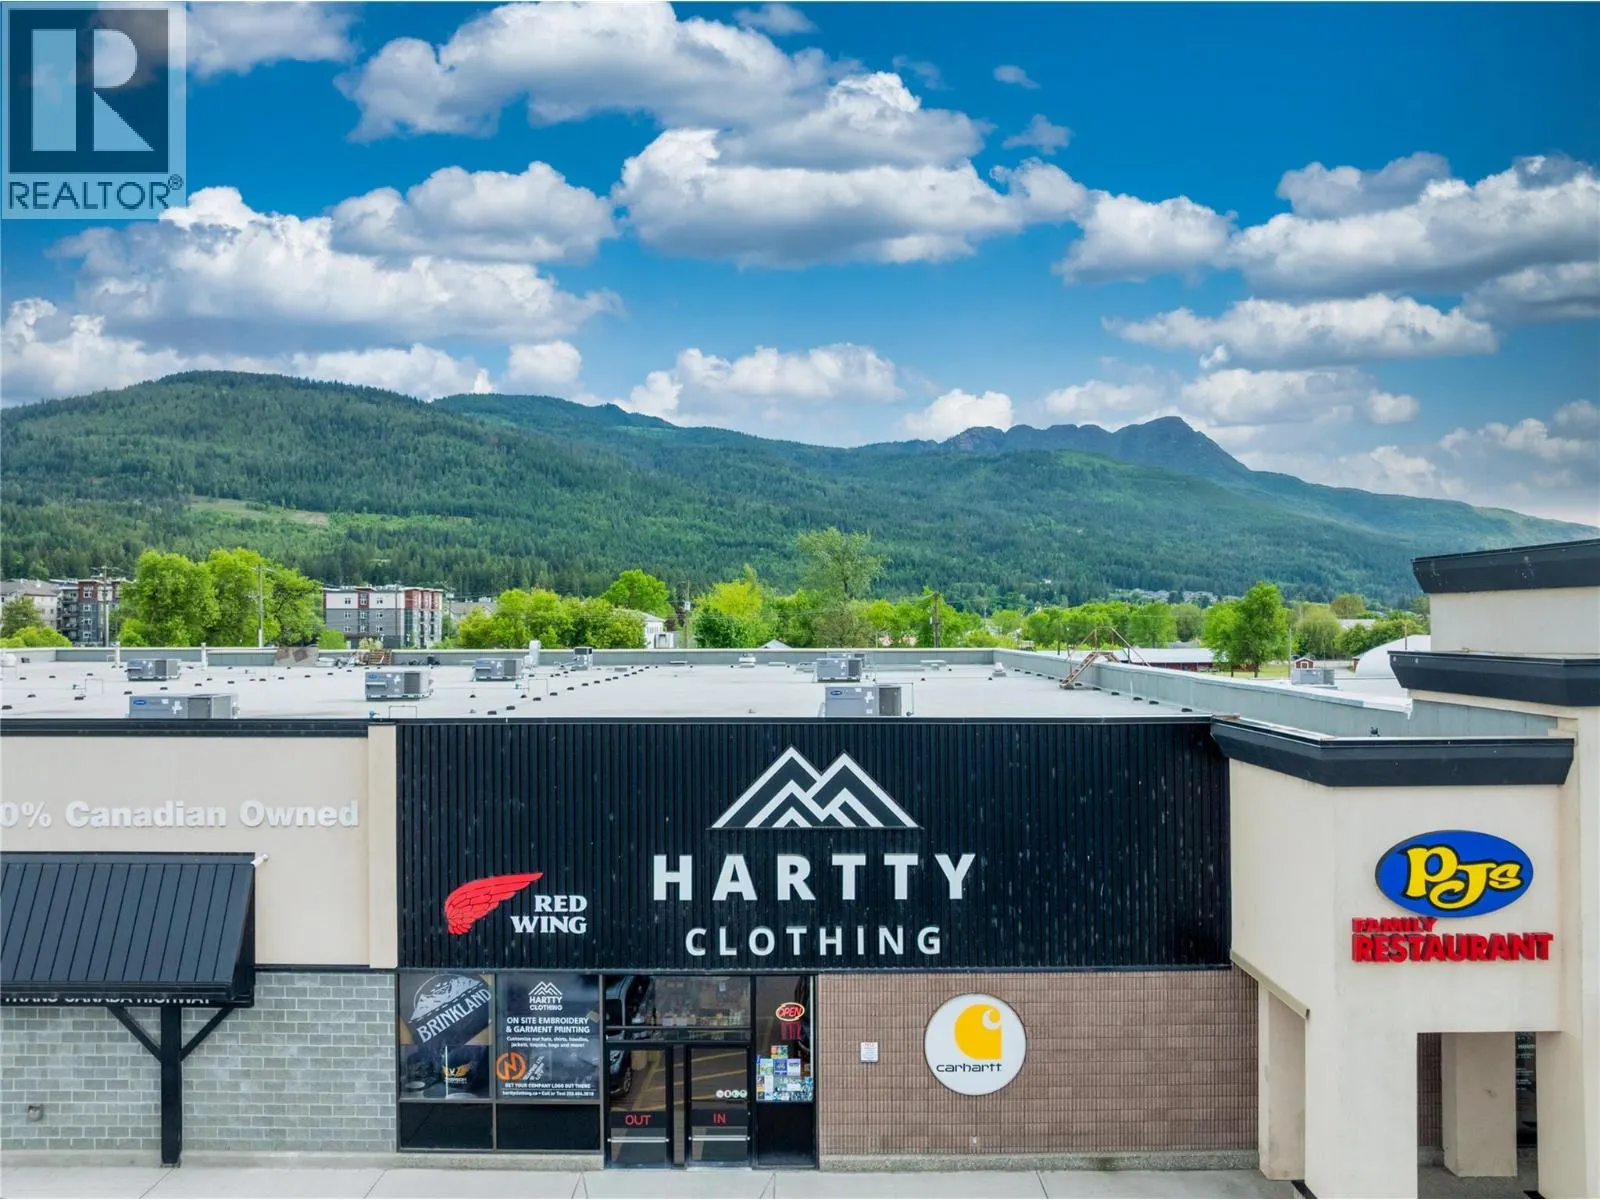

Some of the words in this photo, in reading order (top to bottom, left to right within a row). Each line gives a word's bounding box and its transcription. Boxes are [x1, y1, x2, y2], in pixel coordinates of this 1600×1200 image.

[65, 799, 227, 828] Canadian
[239, 799, 359, 828] Owned
[653, 854, 976, 901] HARTTY
[534, 895, 588, 913] RED
[510, 915, 588, 935] WING
[1352, 917, 1438, 932] FAMILY
[685, 926, 942, 957] CLOTHING
[1352, 932, 1554, 962] RESTAURANT
[529, 996, 563, 1004] HARTTY
[416, 988, 492, 1044] BRINKLAND
[778, 1006, 803, 1018] OPEN
[505, 1025, 512, 1033] &
[513, 1025, 553, 1033] GARMENT
[554, 1025, 590, 1033] PRINTING
[936, 1063, 1003, 1073] carhartt
[624, 1114, 651, 1126] OUT
[713, 1112, 727, 1124] IN
